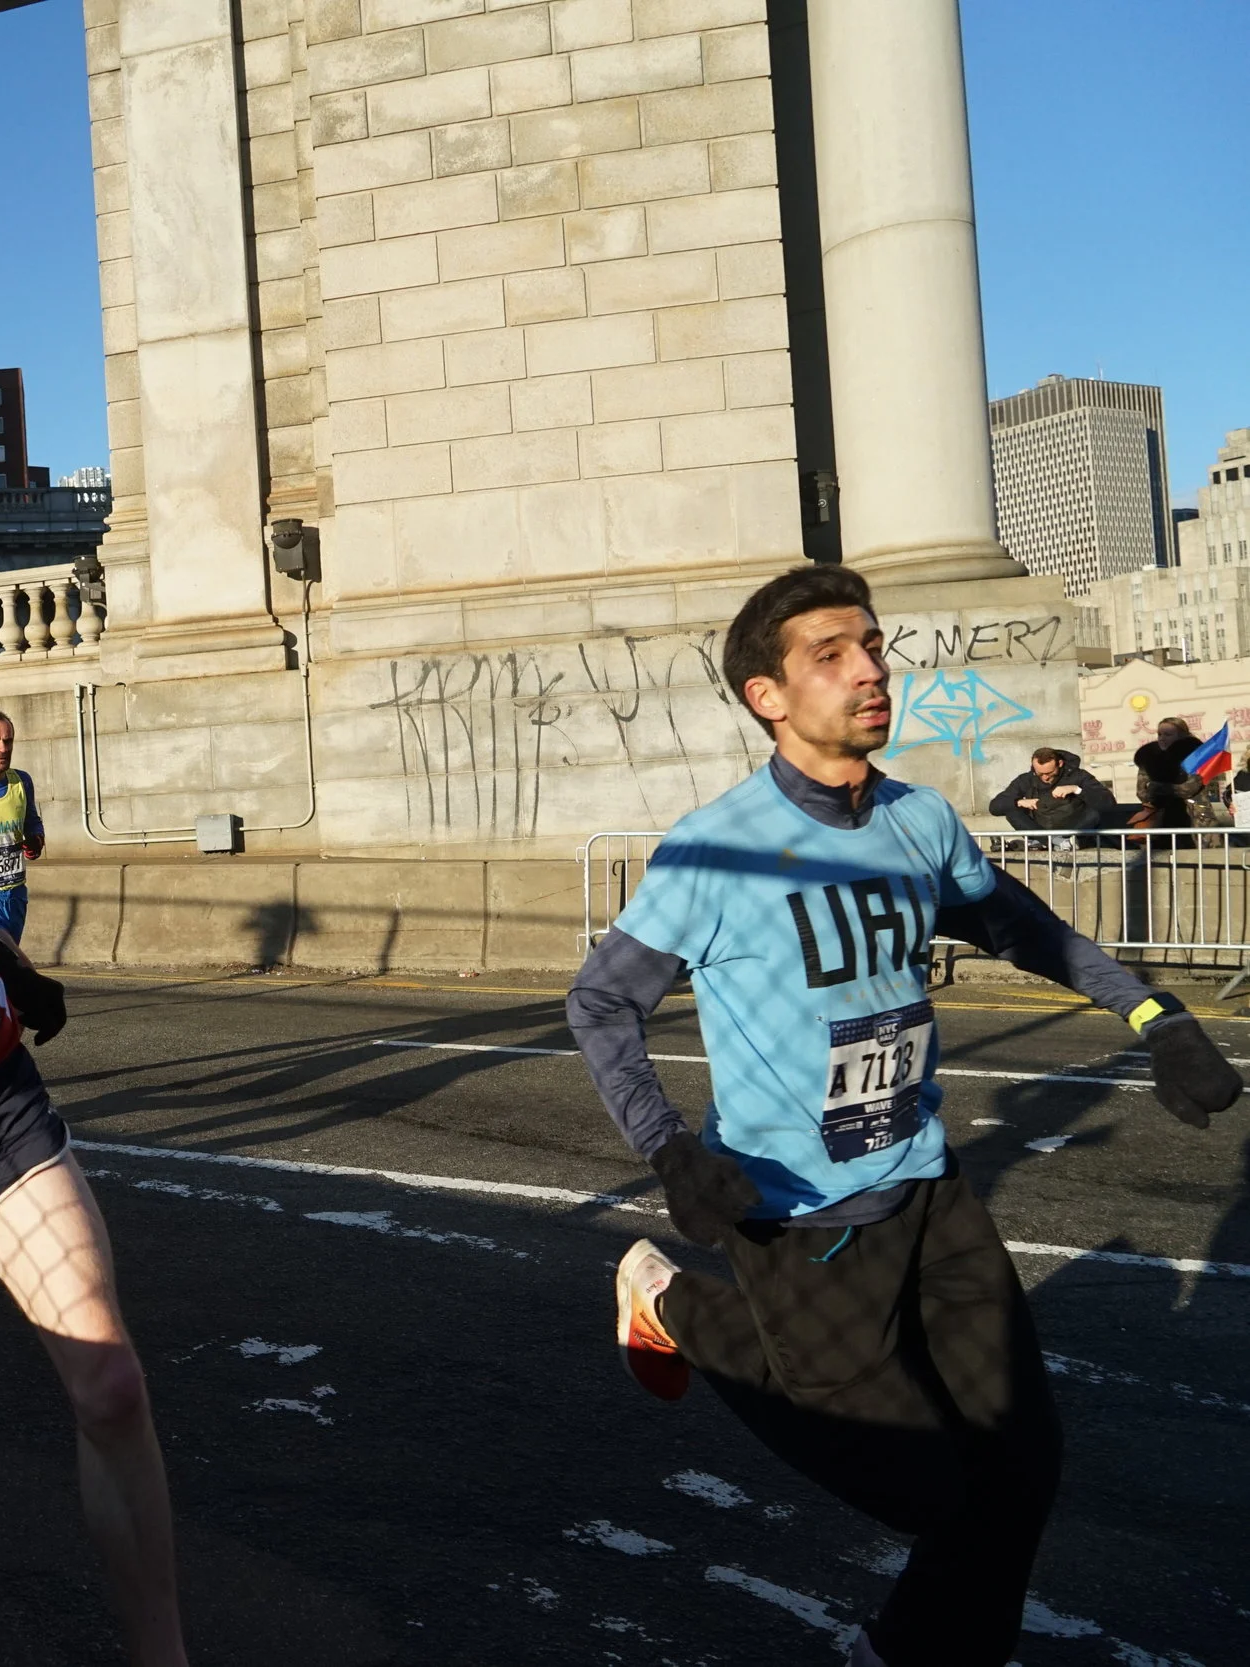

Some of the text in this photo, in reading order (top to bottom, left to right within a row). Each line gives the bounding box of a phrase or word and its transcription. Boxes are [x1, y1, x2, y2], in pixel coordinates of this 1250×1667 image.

[879, 1022, 898, 1036] NYC
[828, 1041, 914, 1098] A 7123
[865, 1099, 893, 1113] WAVE
[865, 1134, 894, 1152] 7123
